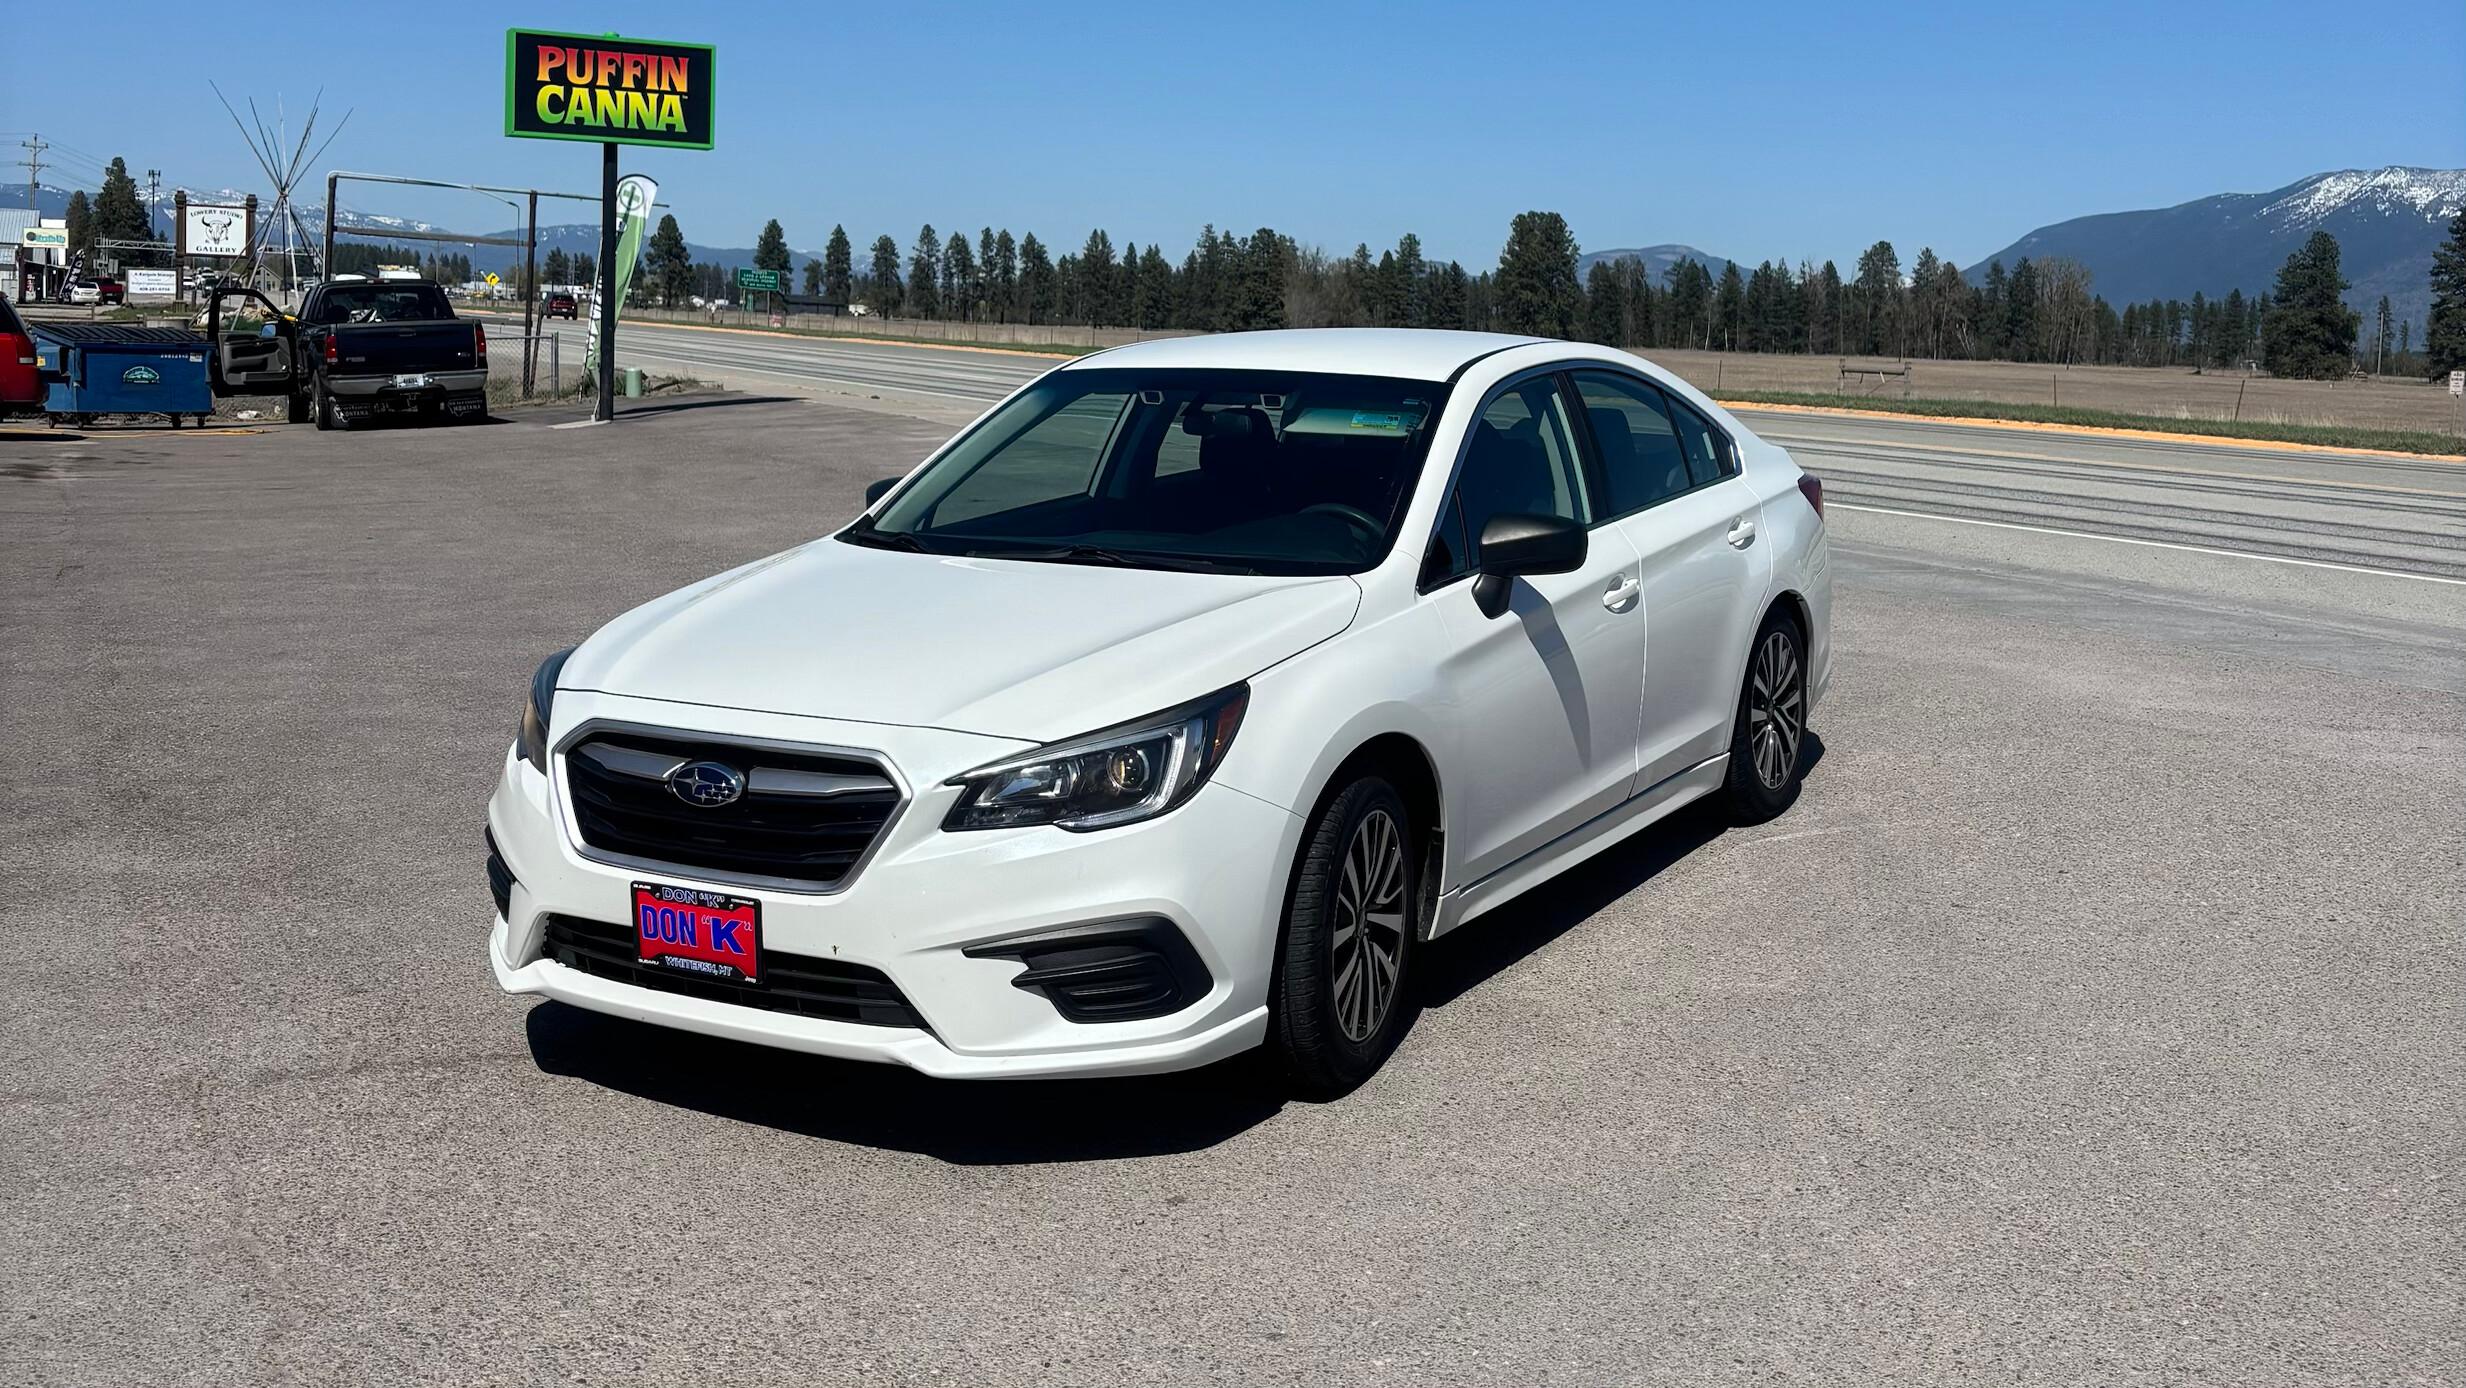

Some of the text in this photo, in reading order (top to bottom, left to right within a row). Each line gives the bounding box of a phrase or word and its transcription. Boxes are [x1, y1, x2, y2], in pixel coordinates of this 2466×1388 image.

[537, 45, 690, 92] PUFFIN
[536, 84, 688, 133] CANNA
[219, 209, 243, 219] STUDIO
[196, 245, 237, 253] GALLERY
[662, 887, 698, 905] DON
[640, 904, 699, 948] DON
[665, 955, 733, 977] WHITEFISH, MT
